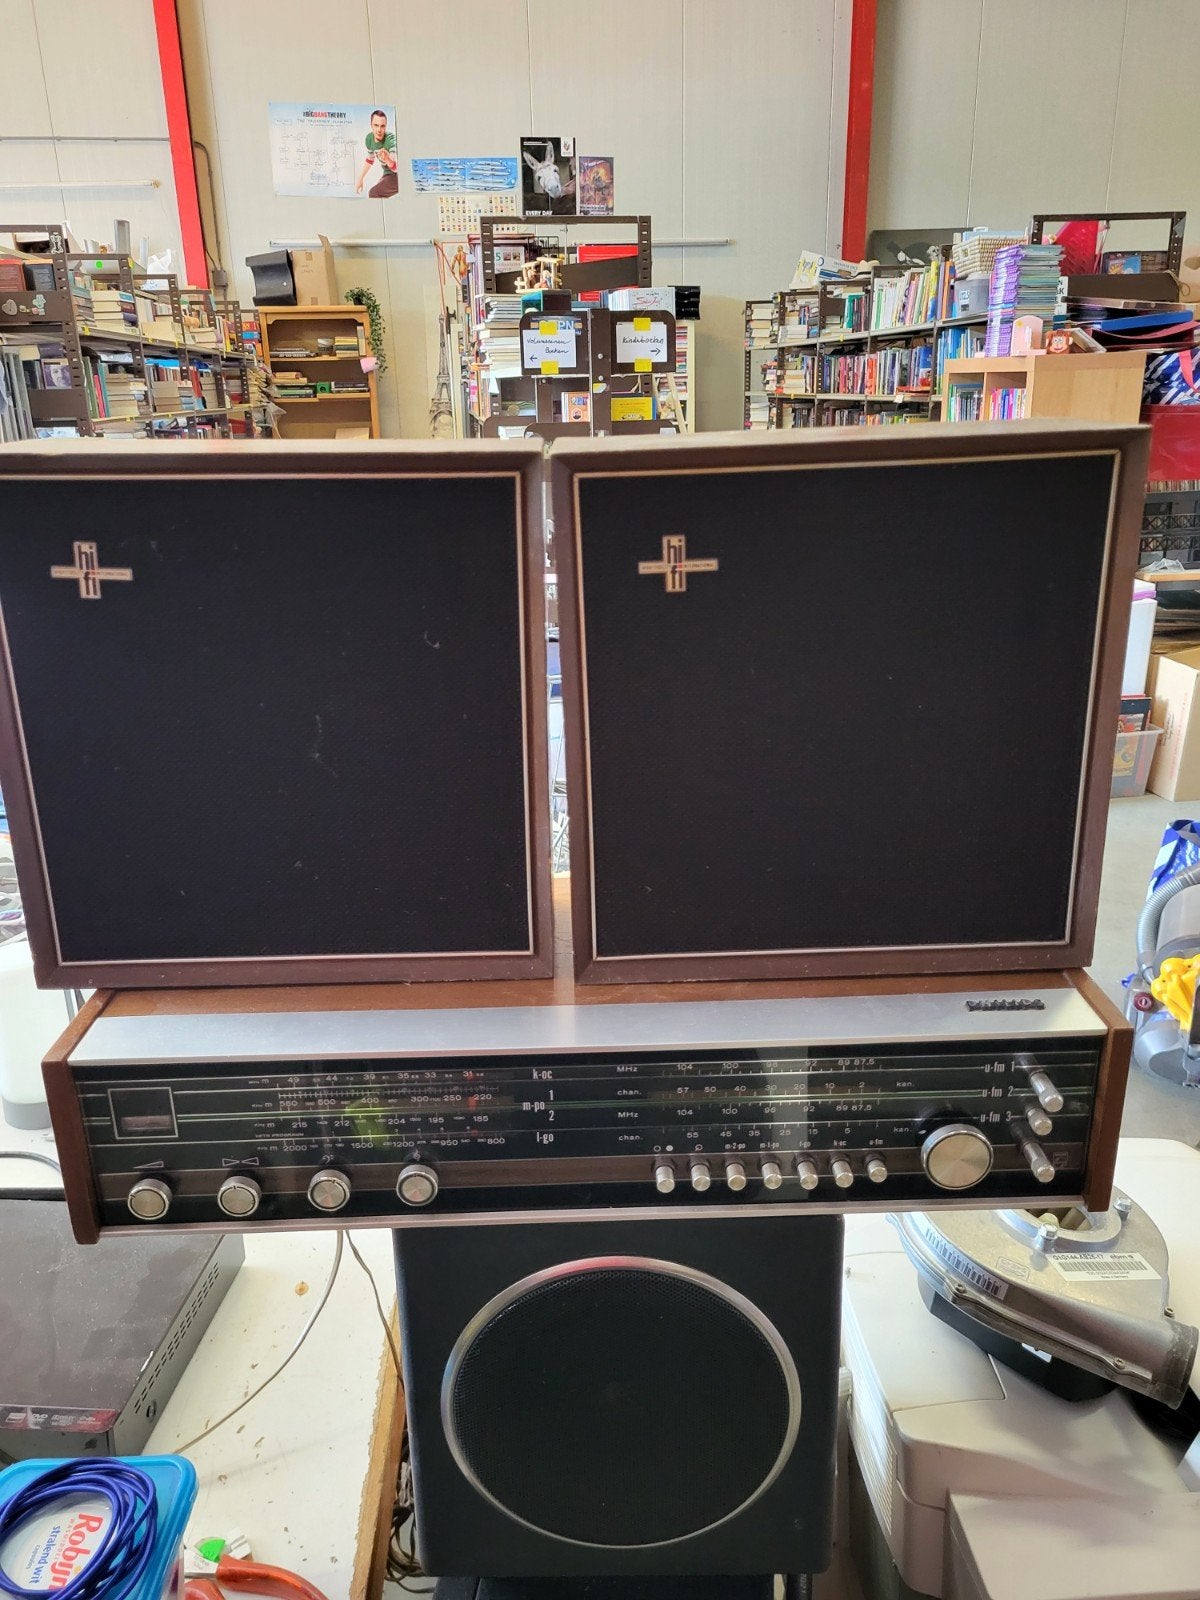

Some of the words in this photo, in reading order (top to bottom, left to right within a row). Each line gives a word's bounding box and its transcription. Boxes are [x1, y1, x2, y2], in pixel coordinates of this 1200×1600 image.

[667, 538, 683, 564] hi
[77, 545, 95, 571] hi
[616, 1065, 639, 1073] MHz
[805, 1059, 817, 1067] 92
[838, 1058, 850, 1066] 89
[984, 1061, 1005, 1073] u-fm
[1010, 1061, 1015, 1072] 1
[532, 1068, 553, 1080] k-oc
[473, 1093, 492, 1101] 220
[548, 1089, 554, 1101] 1
[617, 1088, 642, 1096] chan.
[982, 1086, 1002, 1098] u-fm
[1008, 1086, 1014, 1097] 2
[522, 1101, 546, 1113] m-po
[548, 1110, 555, 1121] 2
[617, 1110, 639, 1118] MHz
[980, 1112, 1000, 1123] u-fm
[1006, 1112, 1012, 1122] 3
[686, 1131, 699, 1139] 55
[393, 1140, 415, 1148] 1200
[440, 1139, 459, 1147] 950
[487, 1137, 506, 1145] 800
[37, 1525, 62, 1565] stralend
[48, 1513, 104, 1591] Robijn
[28, 1566, 44, 1585] wit
